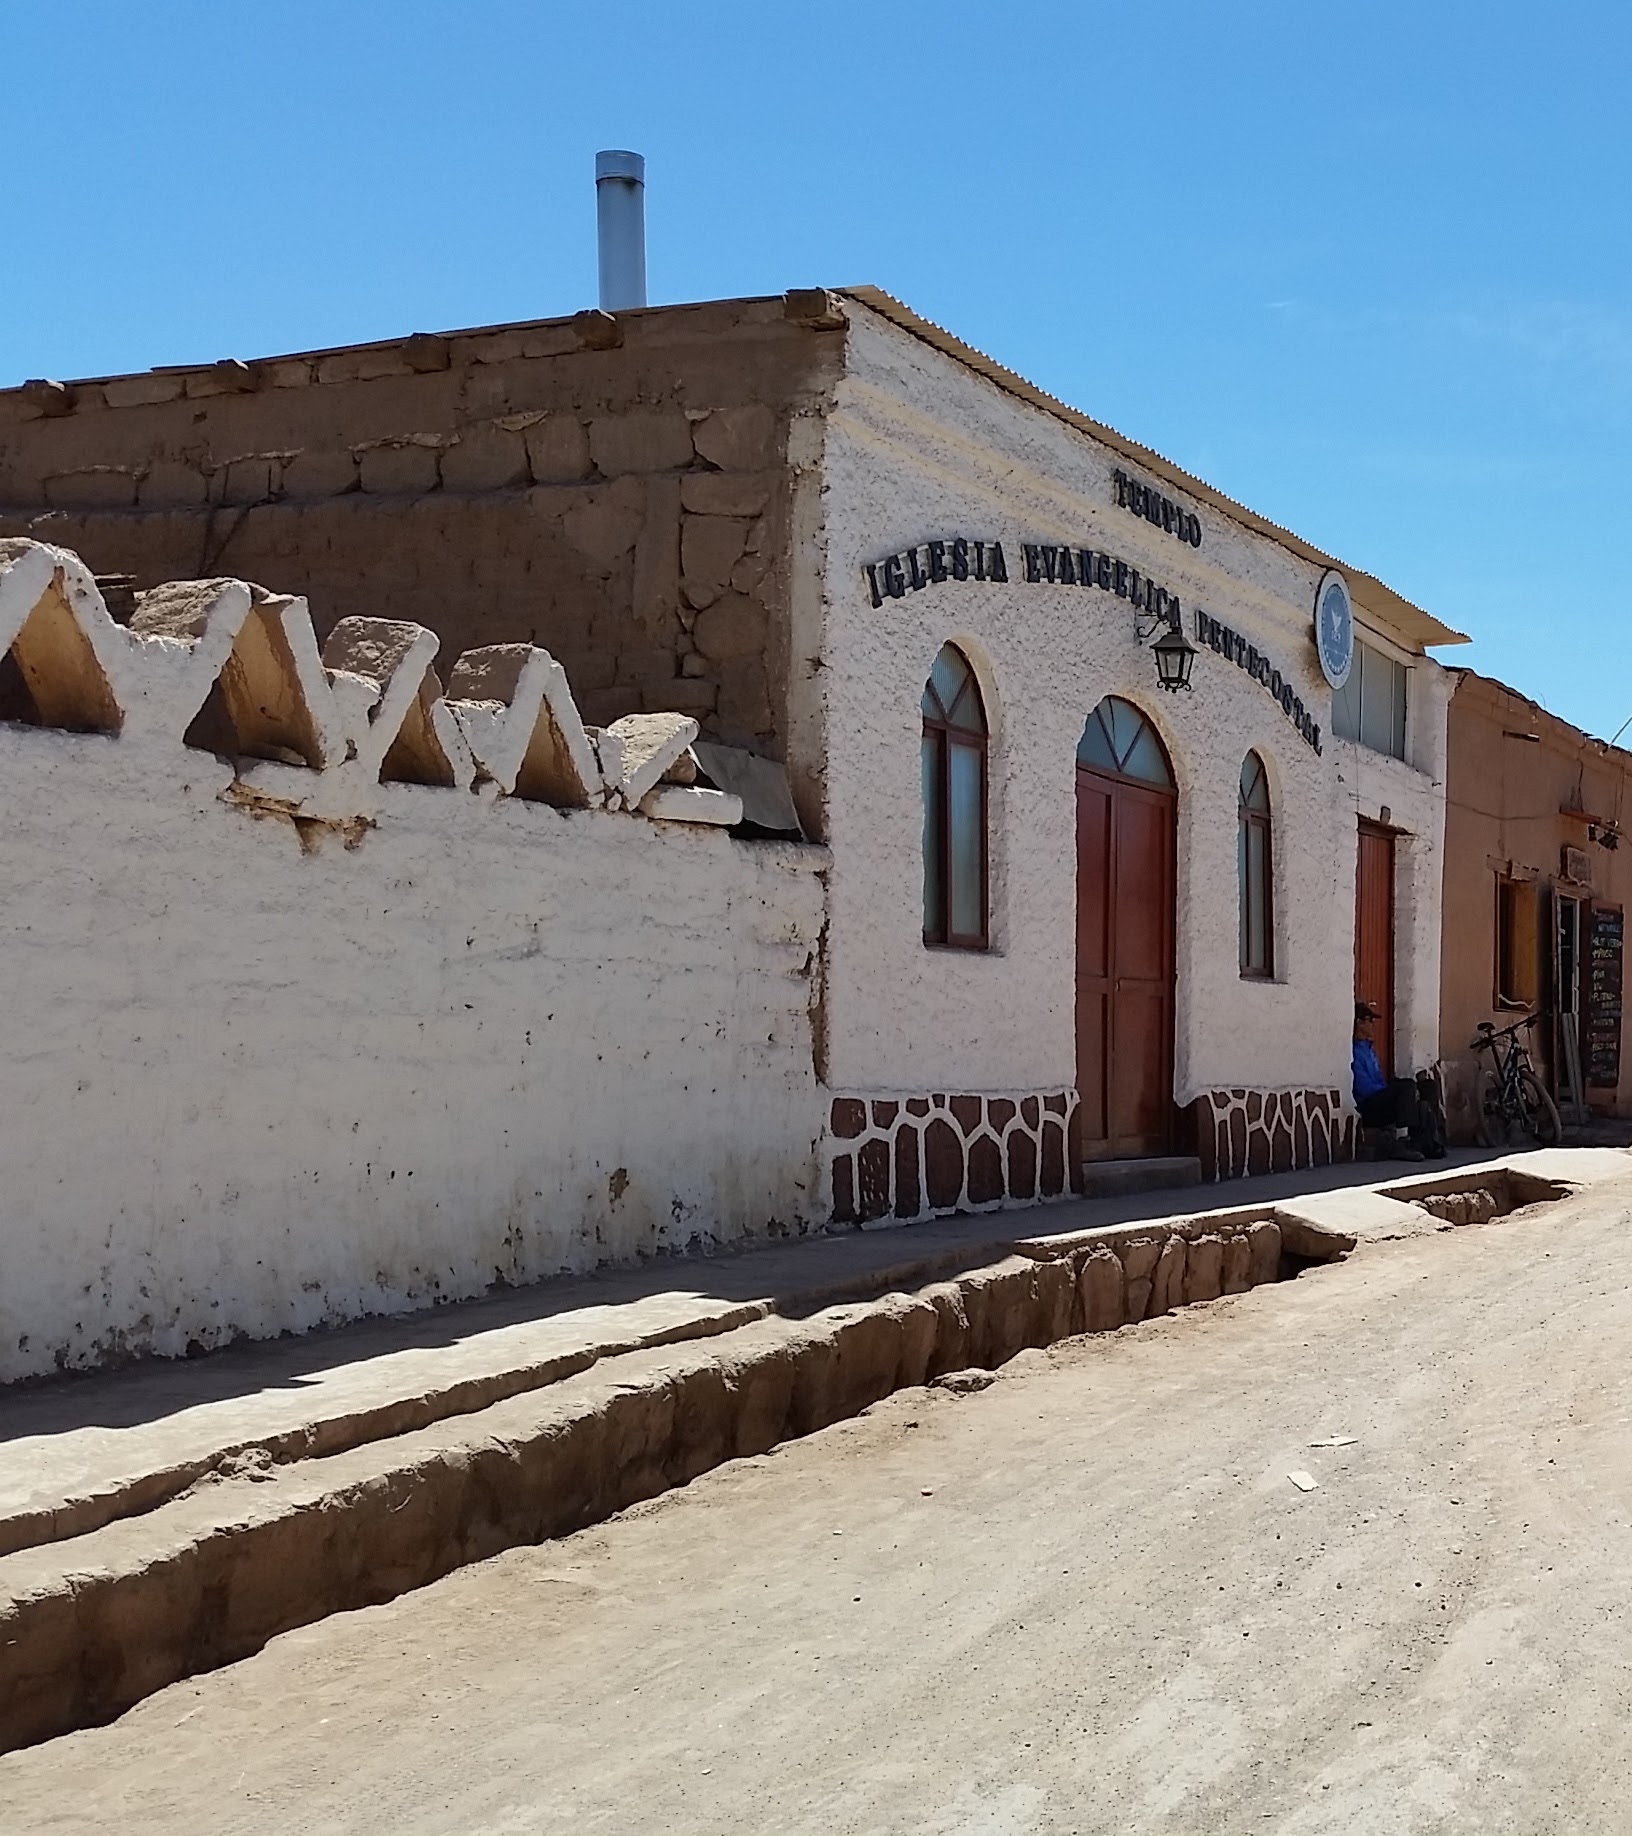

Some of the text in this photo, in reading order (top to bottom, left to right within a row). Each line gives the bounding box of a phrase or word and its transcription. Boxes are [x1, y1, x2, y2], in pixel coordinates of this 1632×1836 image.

[1113, 468, 1202, 548] TEMPLO
[862, 538, 1008, 609] IGLESIA
[1021, 543, 1180, 628] EVANGELICA
[1195, 609, 1322, 757] PENTECOSTAL
